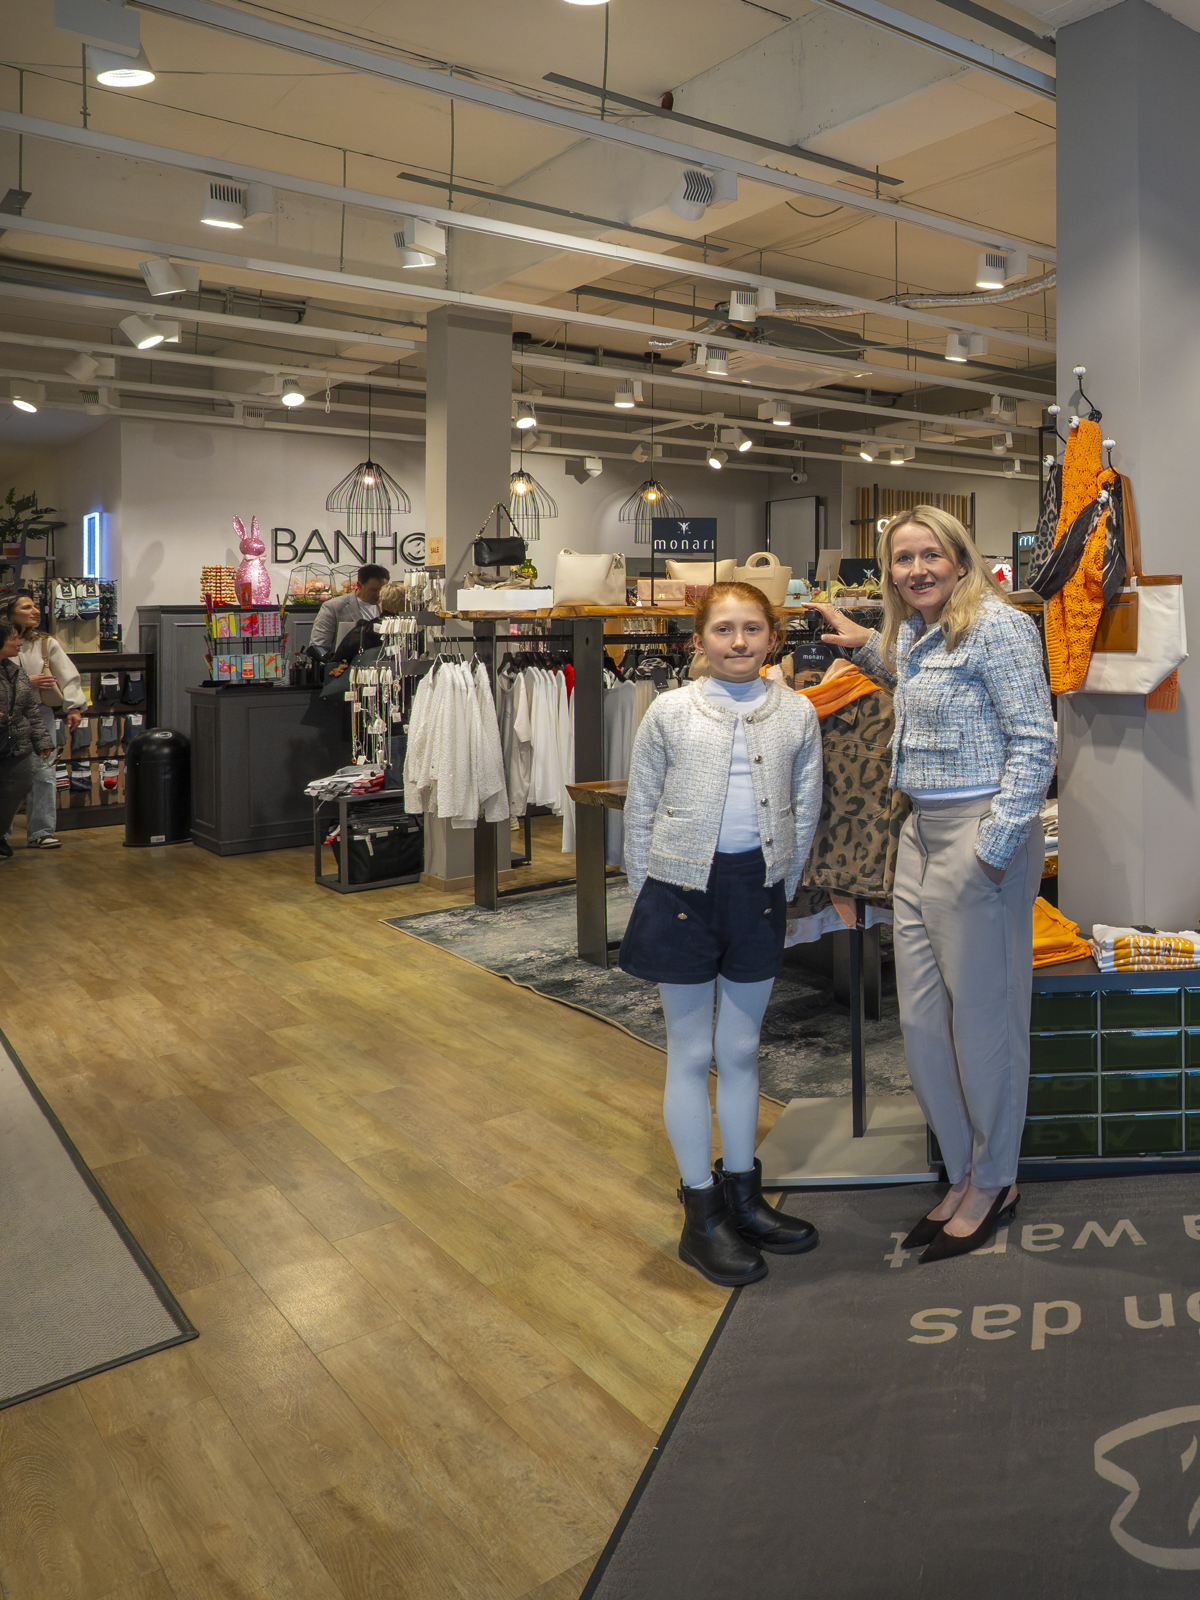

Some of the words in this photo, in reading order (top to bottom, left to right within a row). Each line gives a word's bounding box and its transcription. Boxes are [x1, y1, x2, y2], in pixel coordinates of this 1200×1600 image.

[653, 539, 715, 550] monari
[883, 1218, 1148, 1269] wart
[906, 1300, 1082, 1351] das
